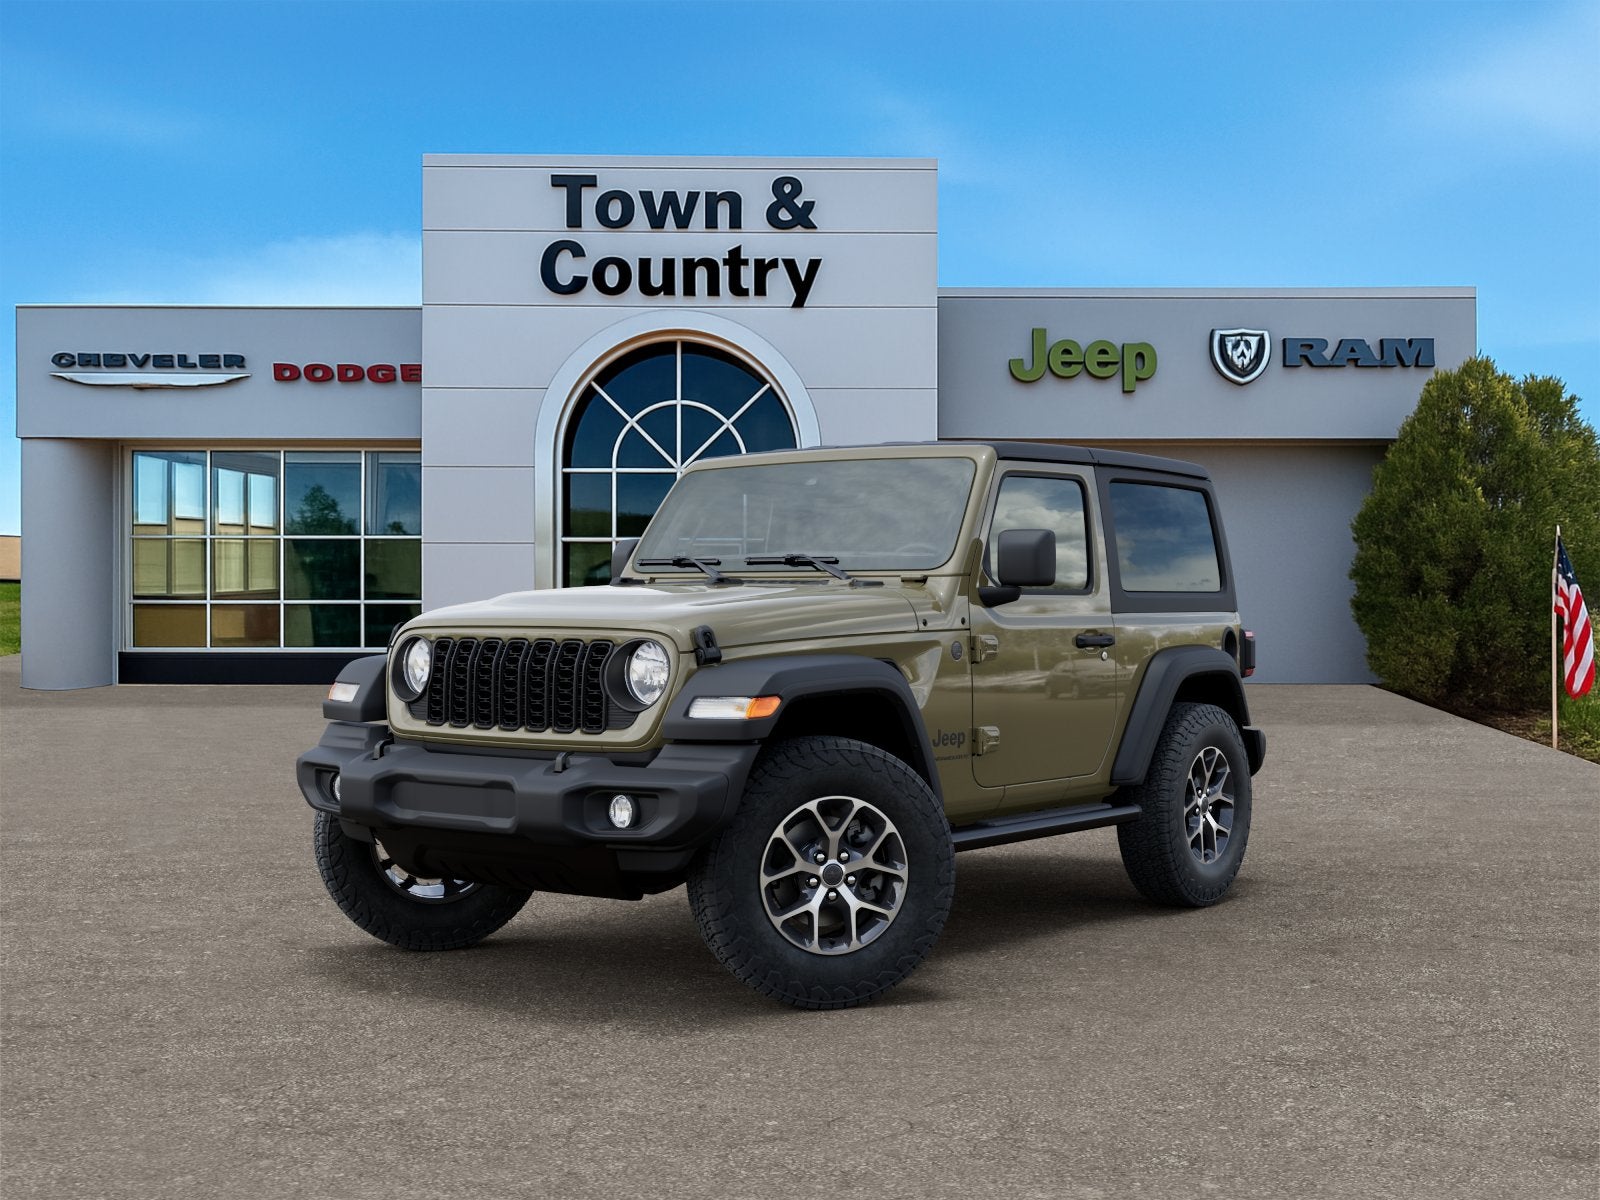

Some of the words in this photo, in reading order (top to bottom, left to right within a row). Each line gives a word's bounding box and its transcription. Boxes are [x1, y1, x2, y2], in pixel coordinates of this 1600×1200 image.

[550, 174, 743, 229] Town
[765, 176, 818, 230] &
[540, 239, 822, 308] Country
[273, 363, 422, 383] DODGE
[1008, 327, 1158, 393] Jeep
[1282, 337, 1436, 368] RAM
[932, 729, 966, 748] Jeep
